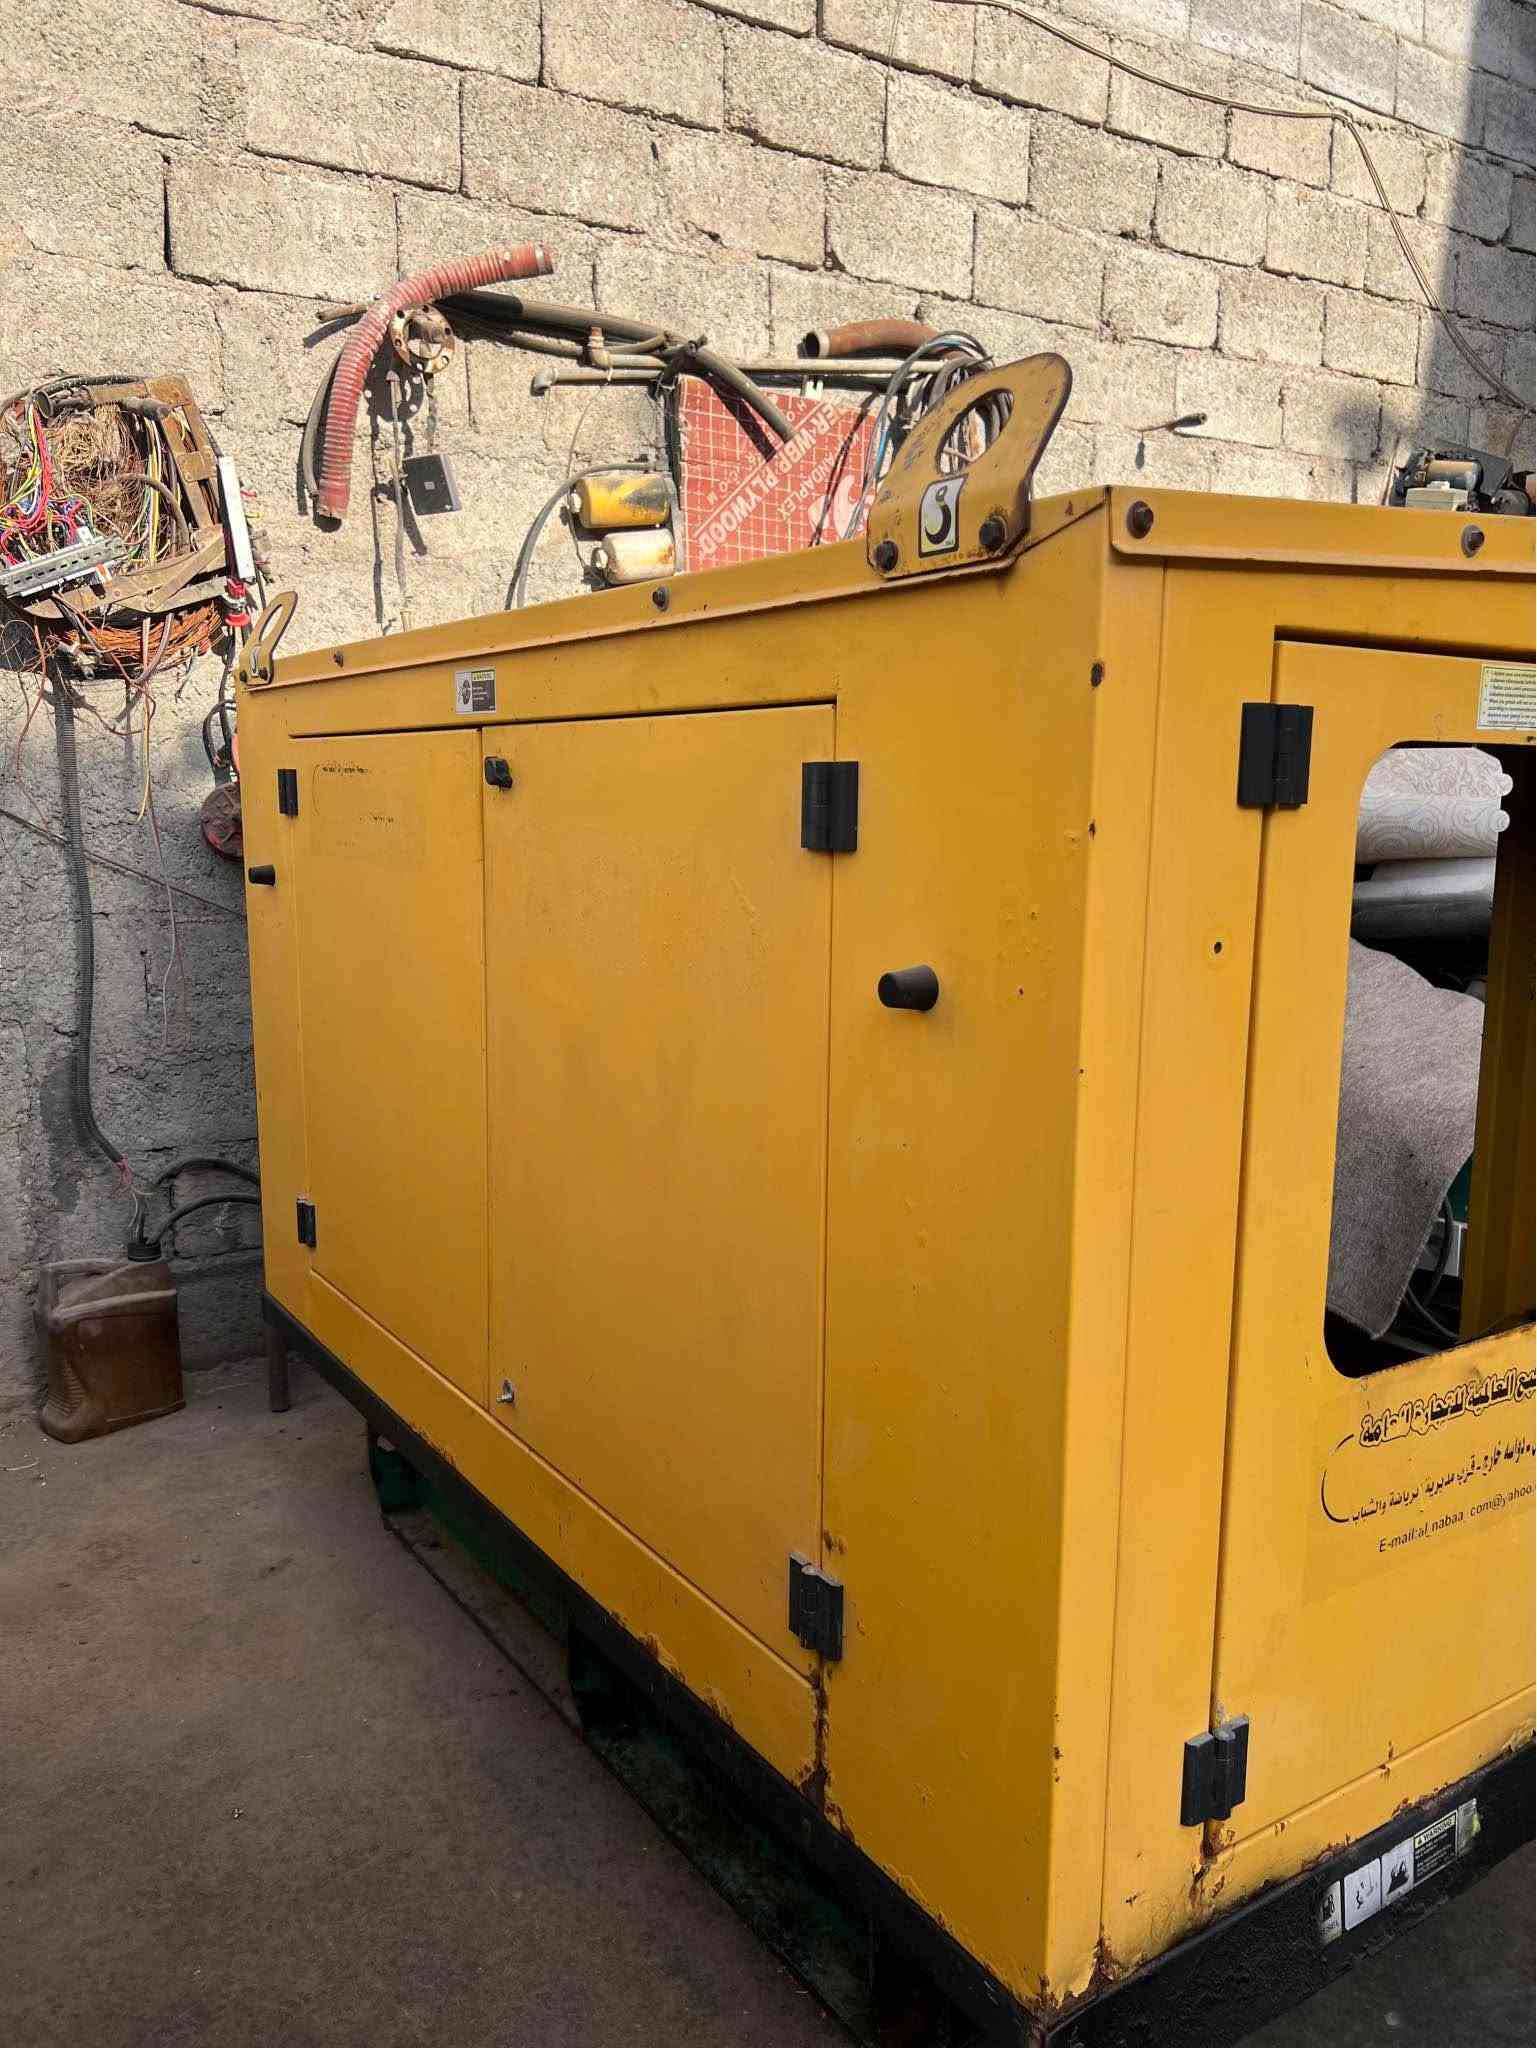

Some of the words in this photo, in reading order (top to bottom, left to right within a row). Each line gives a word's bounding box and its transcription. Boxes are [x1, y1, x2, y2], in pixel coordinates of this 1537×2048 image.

[699, 464, 780, 555] PLYWOOD
[777, 449, 840, 521] ANDAPLEX
[1359, 1401, 1411, 1447] العامة
[1411, 1384, 1466, 1436] للتجارة
